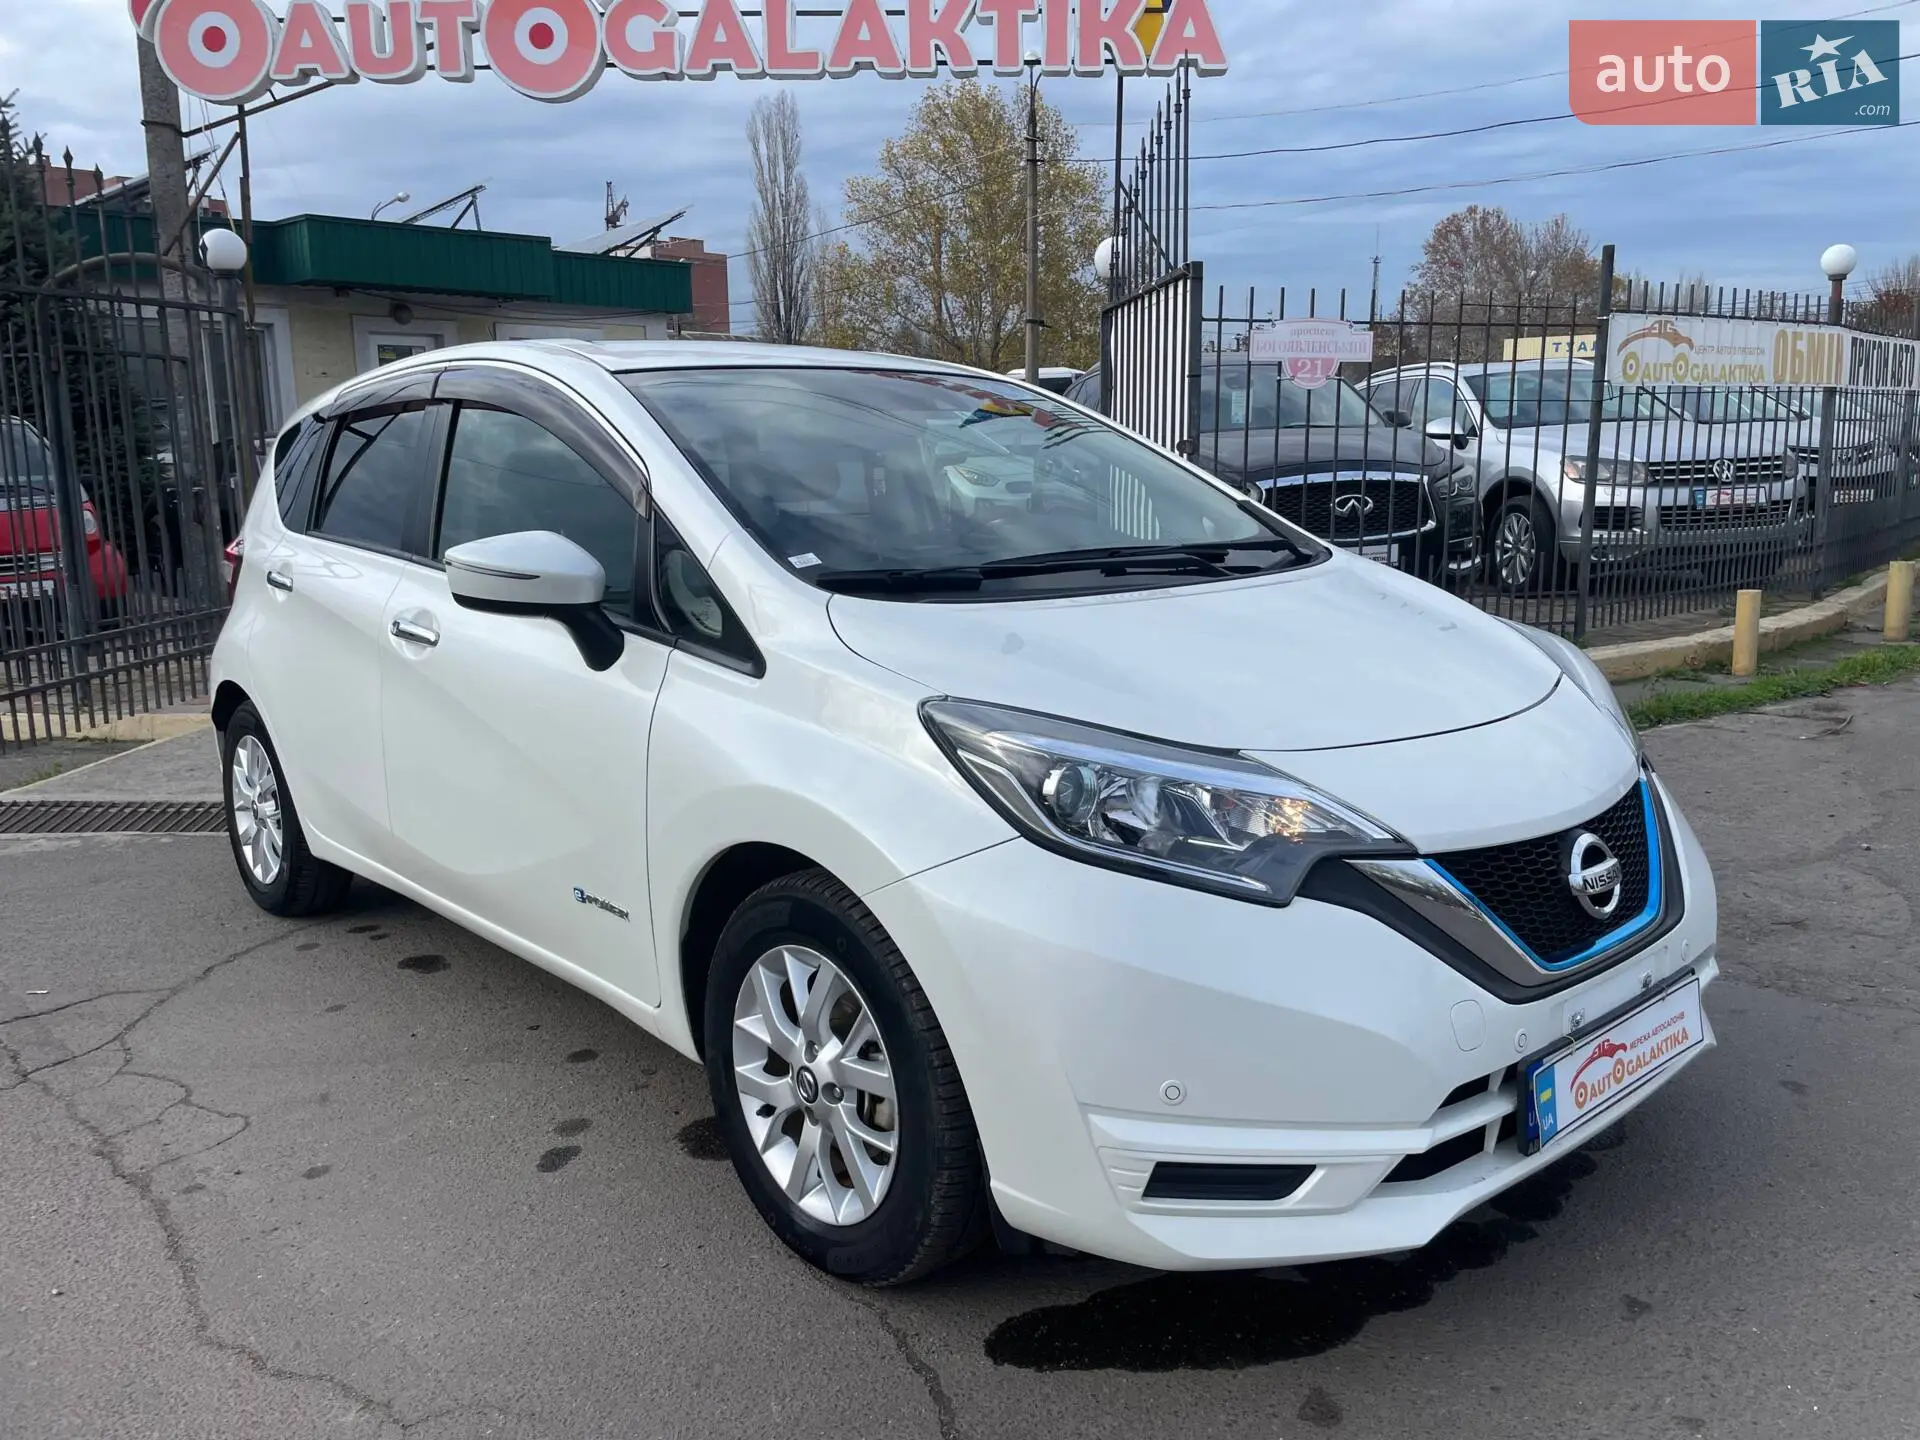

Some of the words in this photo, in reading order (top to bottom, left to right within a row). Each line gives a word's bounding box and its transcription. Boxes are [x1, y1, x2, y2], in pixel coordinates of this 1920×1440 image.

[1289, 327, 1335, 338] проспект
[1297, 359, 1324, 378] 21
[1848, 335, 1890, 387] ПРИГОН
[1890, 342, 1916, 388] АВТО
[1583, 868, 1619, 891] NISSA
[1542, 1112, 1554, 1131] UA
